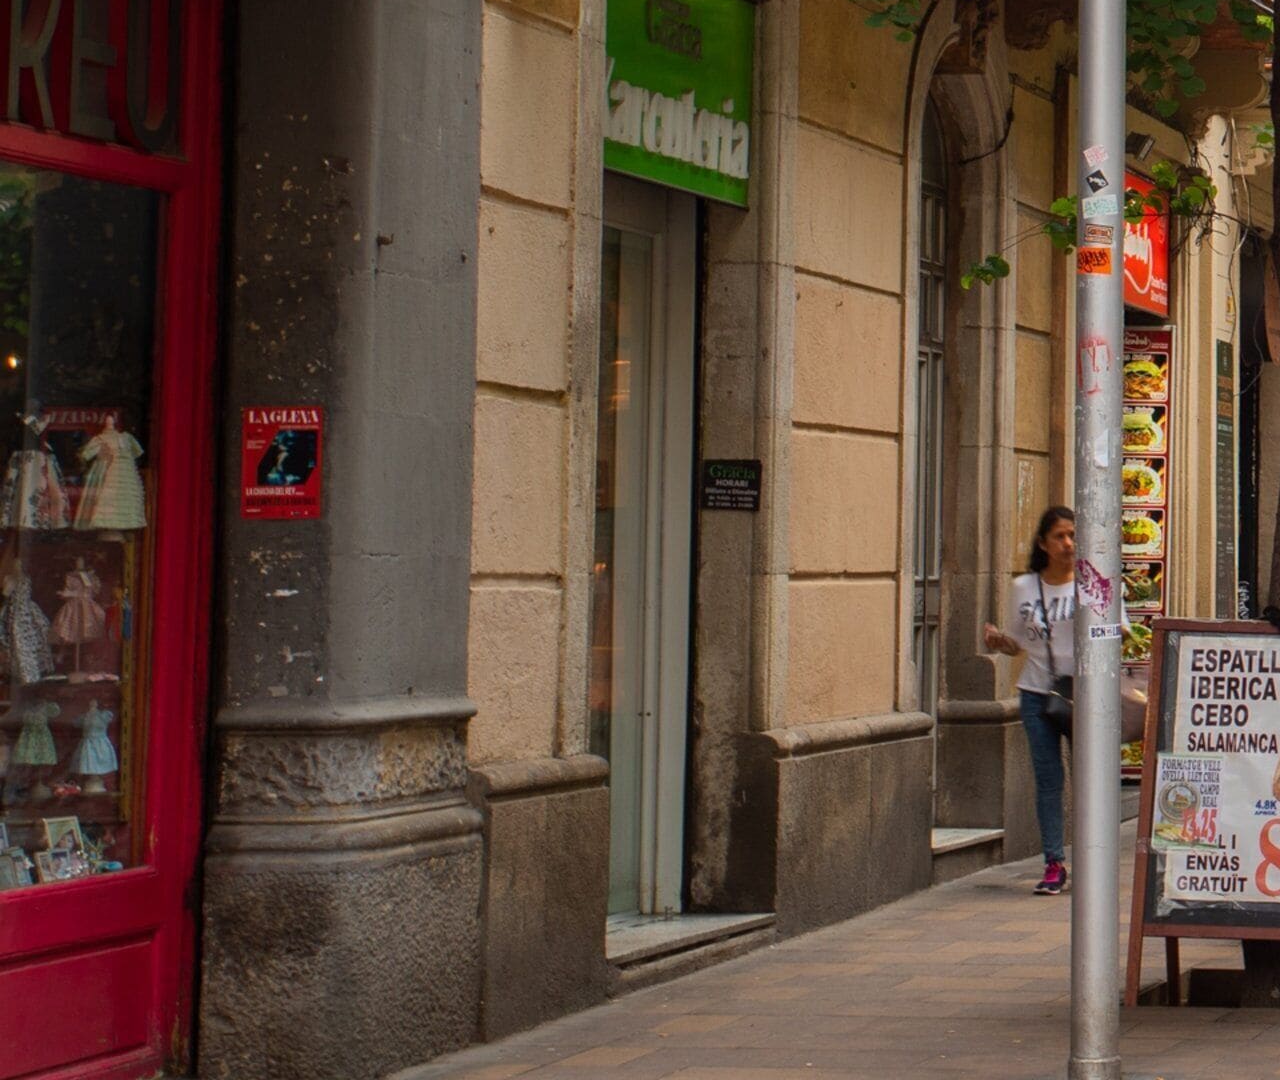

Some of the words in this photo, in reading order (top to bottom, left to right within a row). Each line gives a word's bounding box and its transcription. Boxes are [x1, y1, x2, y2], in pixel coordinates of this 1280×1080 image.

[1190, 677, 1277, 701] IBERICA
[1190, 704, 1249, 727] CEBO
[1187, 732, 1278, 754] SALAMANCA
[1162, 759, 1202, 771] FORMATGE
[1203, 760, 1221, 772] VELL
[1200, 784, 1219, 796] CAMPO
[1186, 850, 1240, 871] ENVÀS
[1176, 872, 1248, 894] GRATUÏT
